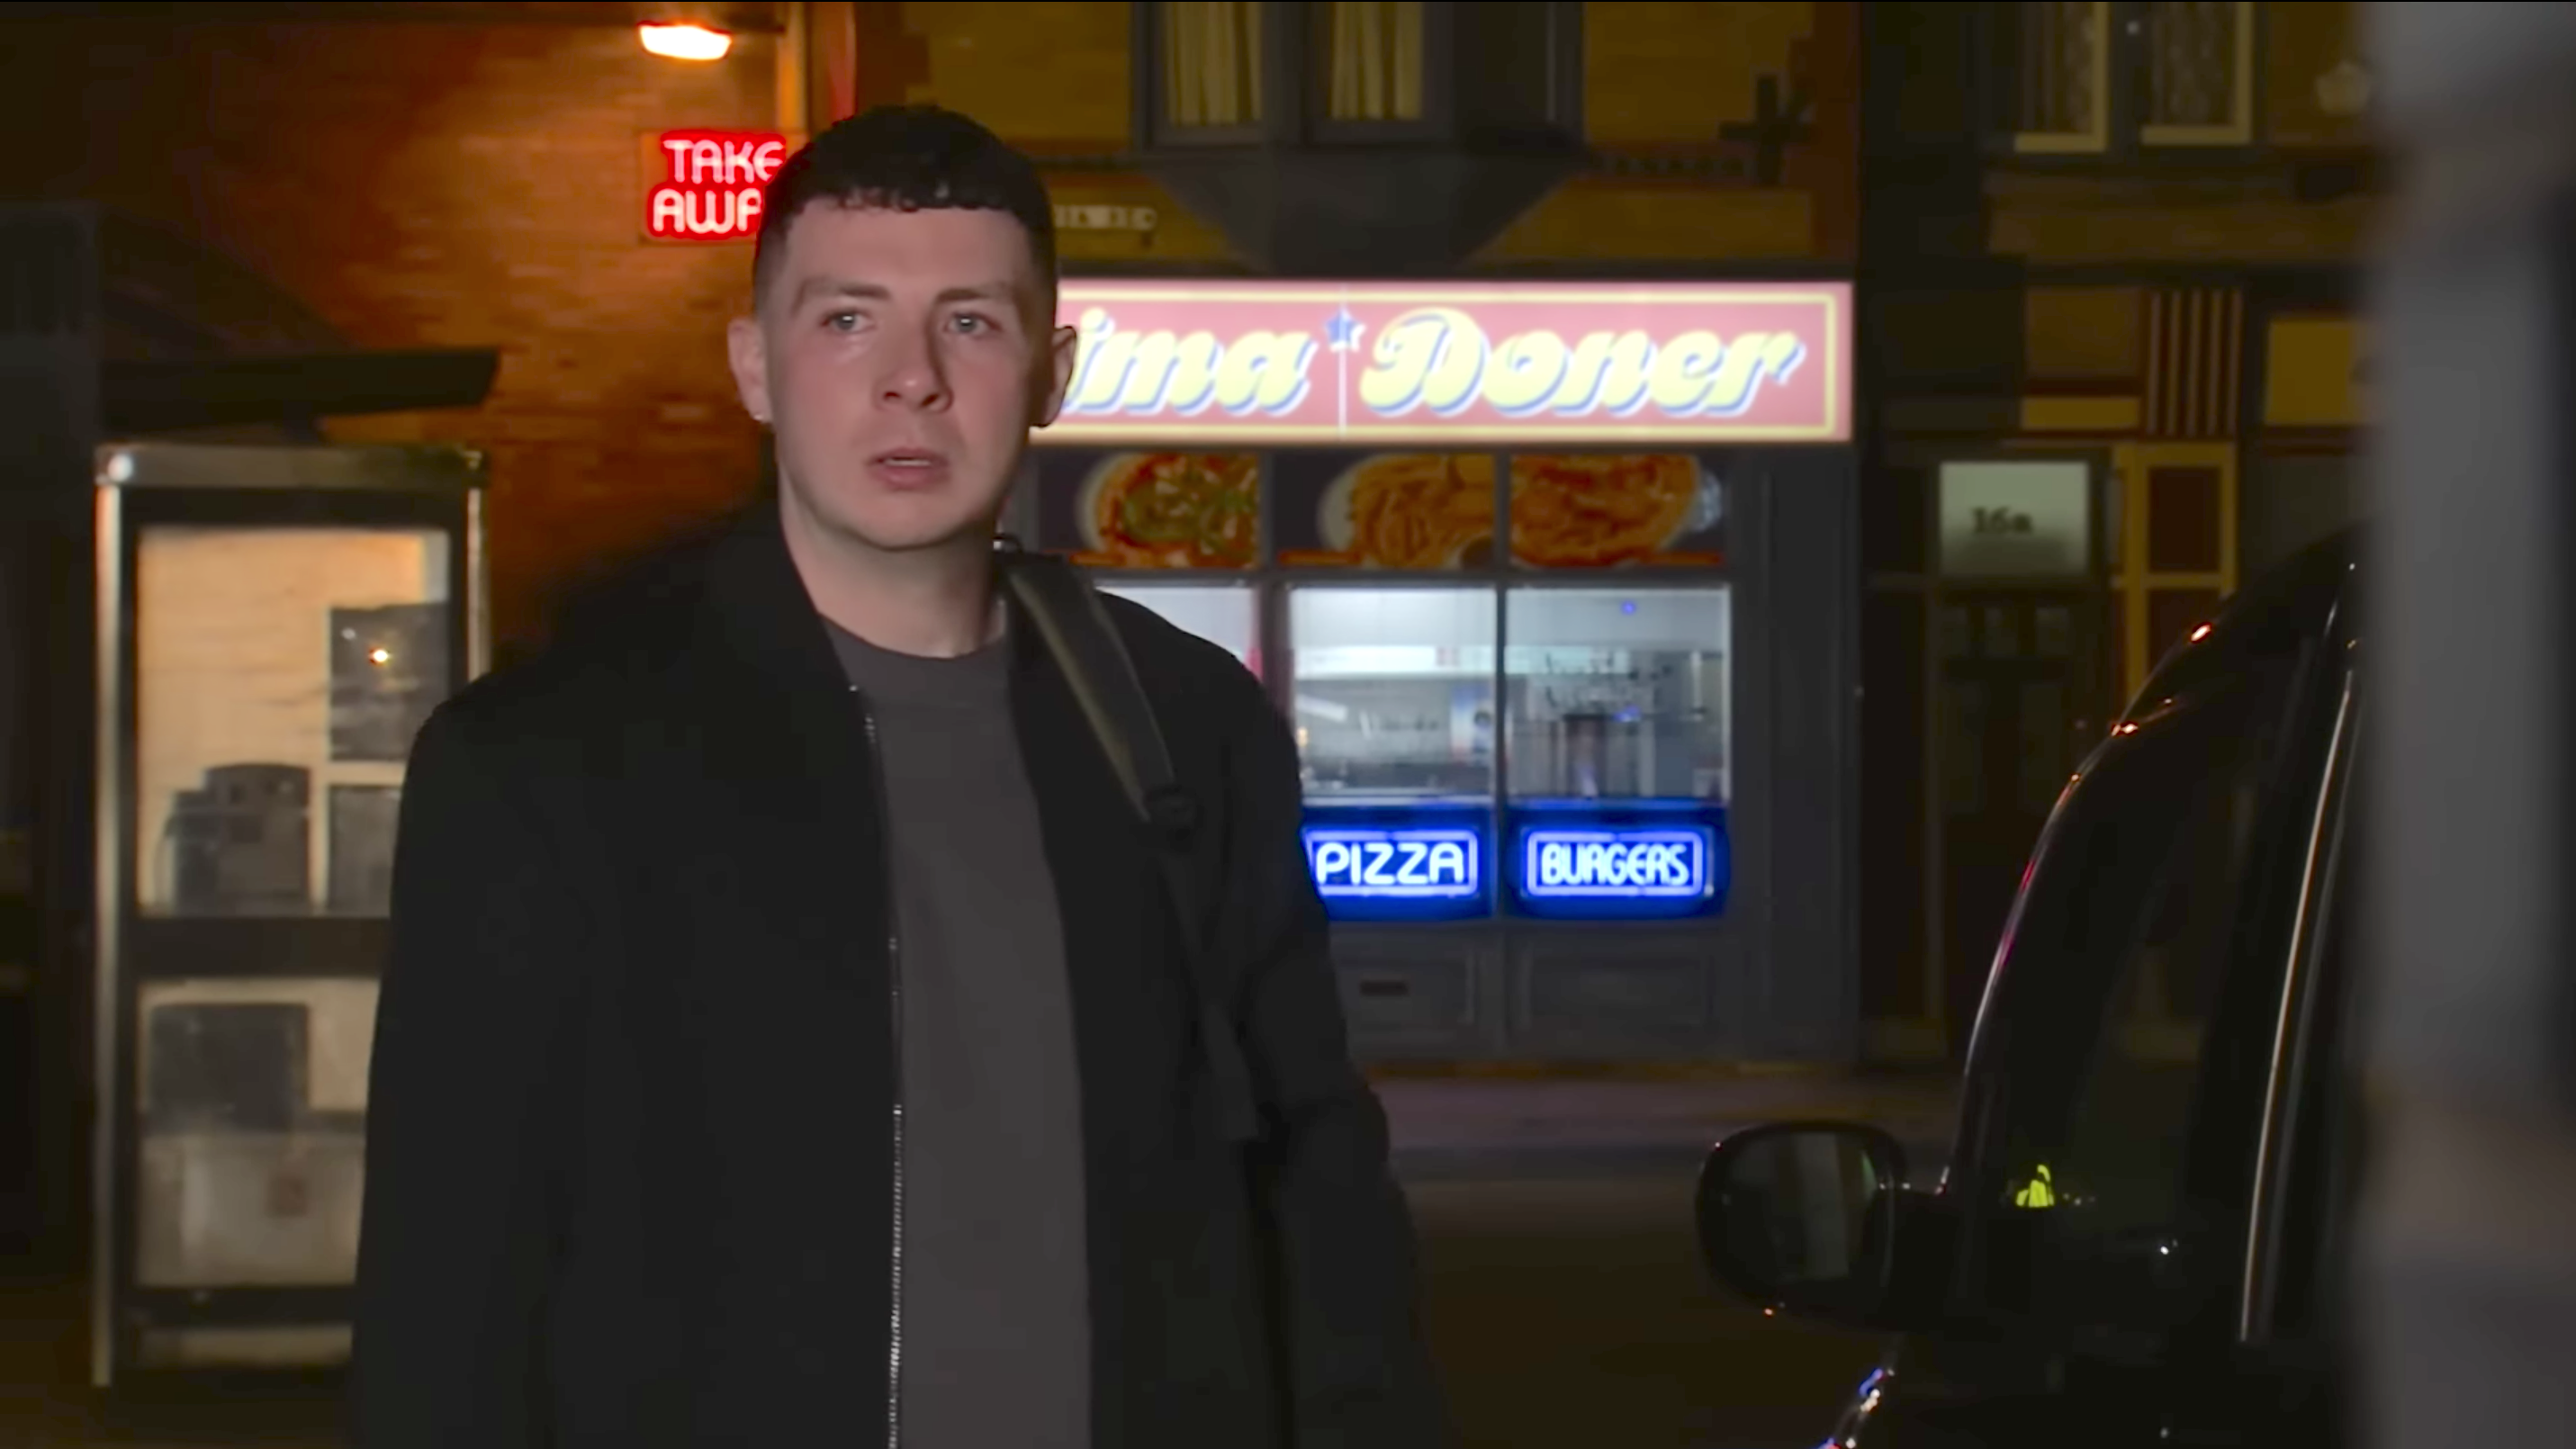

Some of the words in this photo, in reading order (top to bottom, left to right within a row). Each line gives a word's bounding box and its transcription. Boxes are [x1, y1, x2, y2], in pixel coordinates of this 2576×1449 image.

[662, 139, 784, 184] TAKE
[1358, 306, 1807, 418] Doner
[1316, 842, 1464, 886] PIZZA
[1540, 842, 1690, 886] BURGERS
